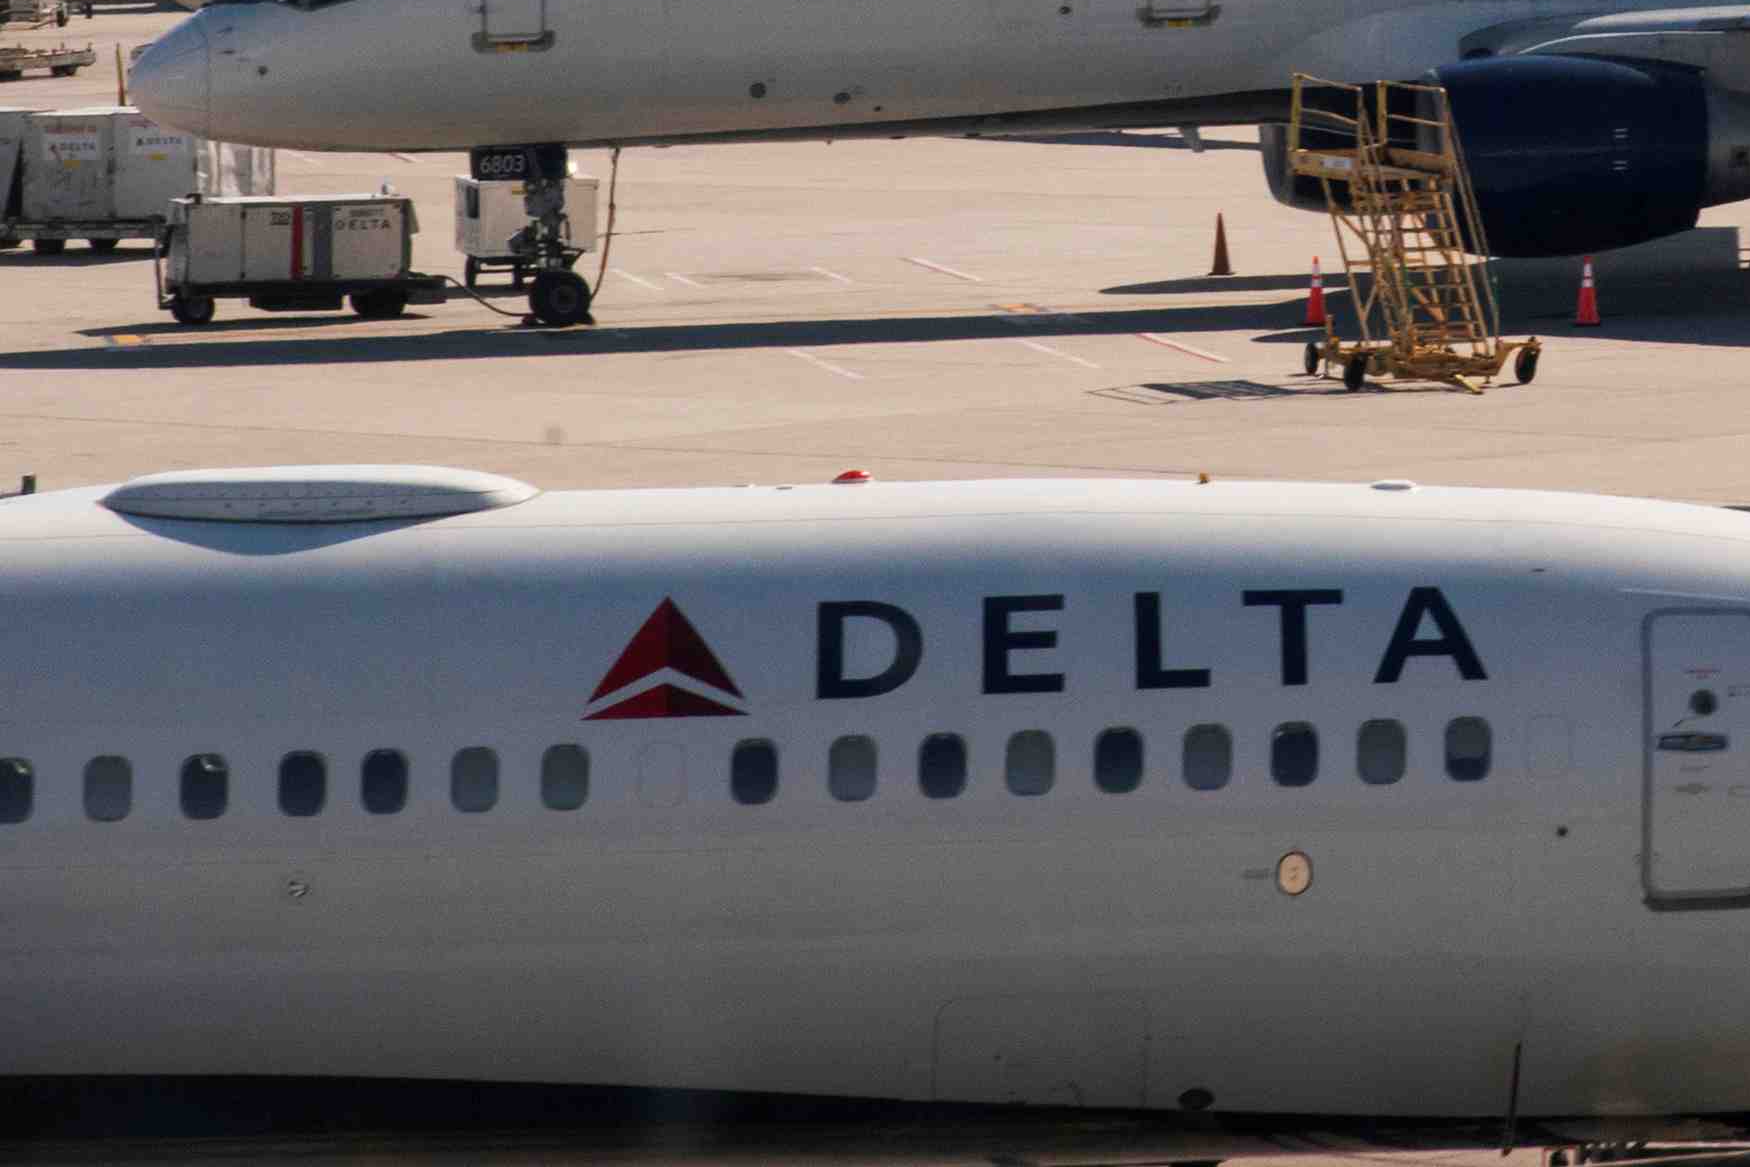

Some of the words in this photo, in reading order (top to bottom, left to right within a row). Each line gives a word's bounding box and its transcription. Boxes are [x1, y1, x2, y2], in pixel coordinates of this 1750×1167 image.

[480, 154, 525, 173] 6803
[335, 219, 392, 231] DELTA
[815, 586, 1489, 700] DELTA
